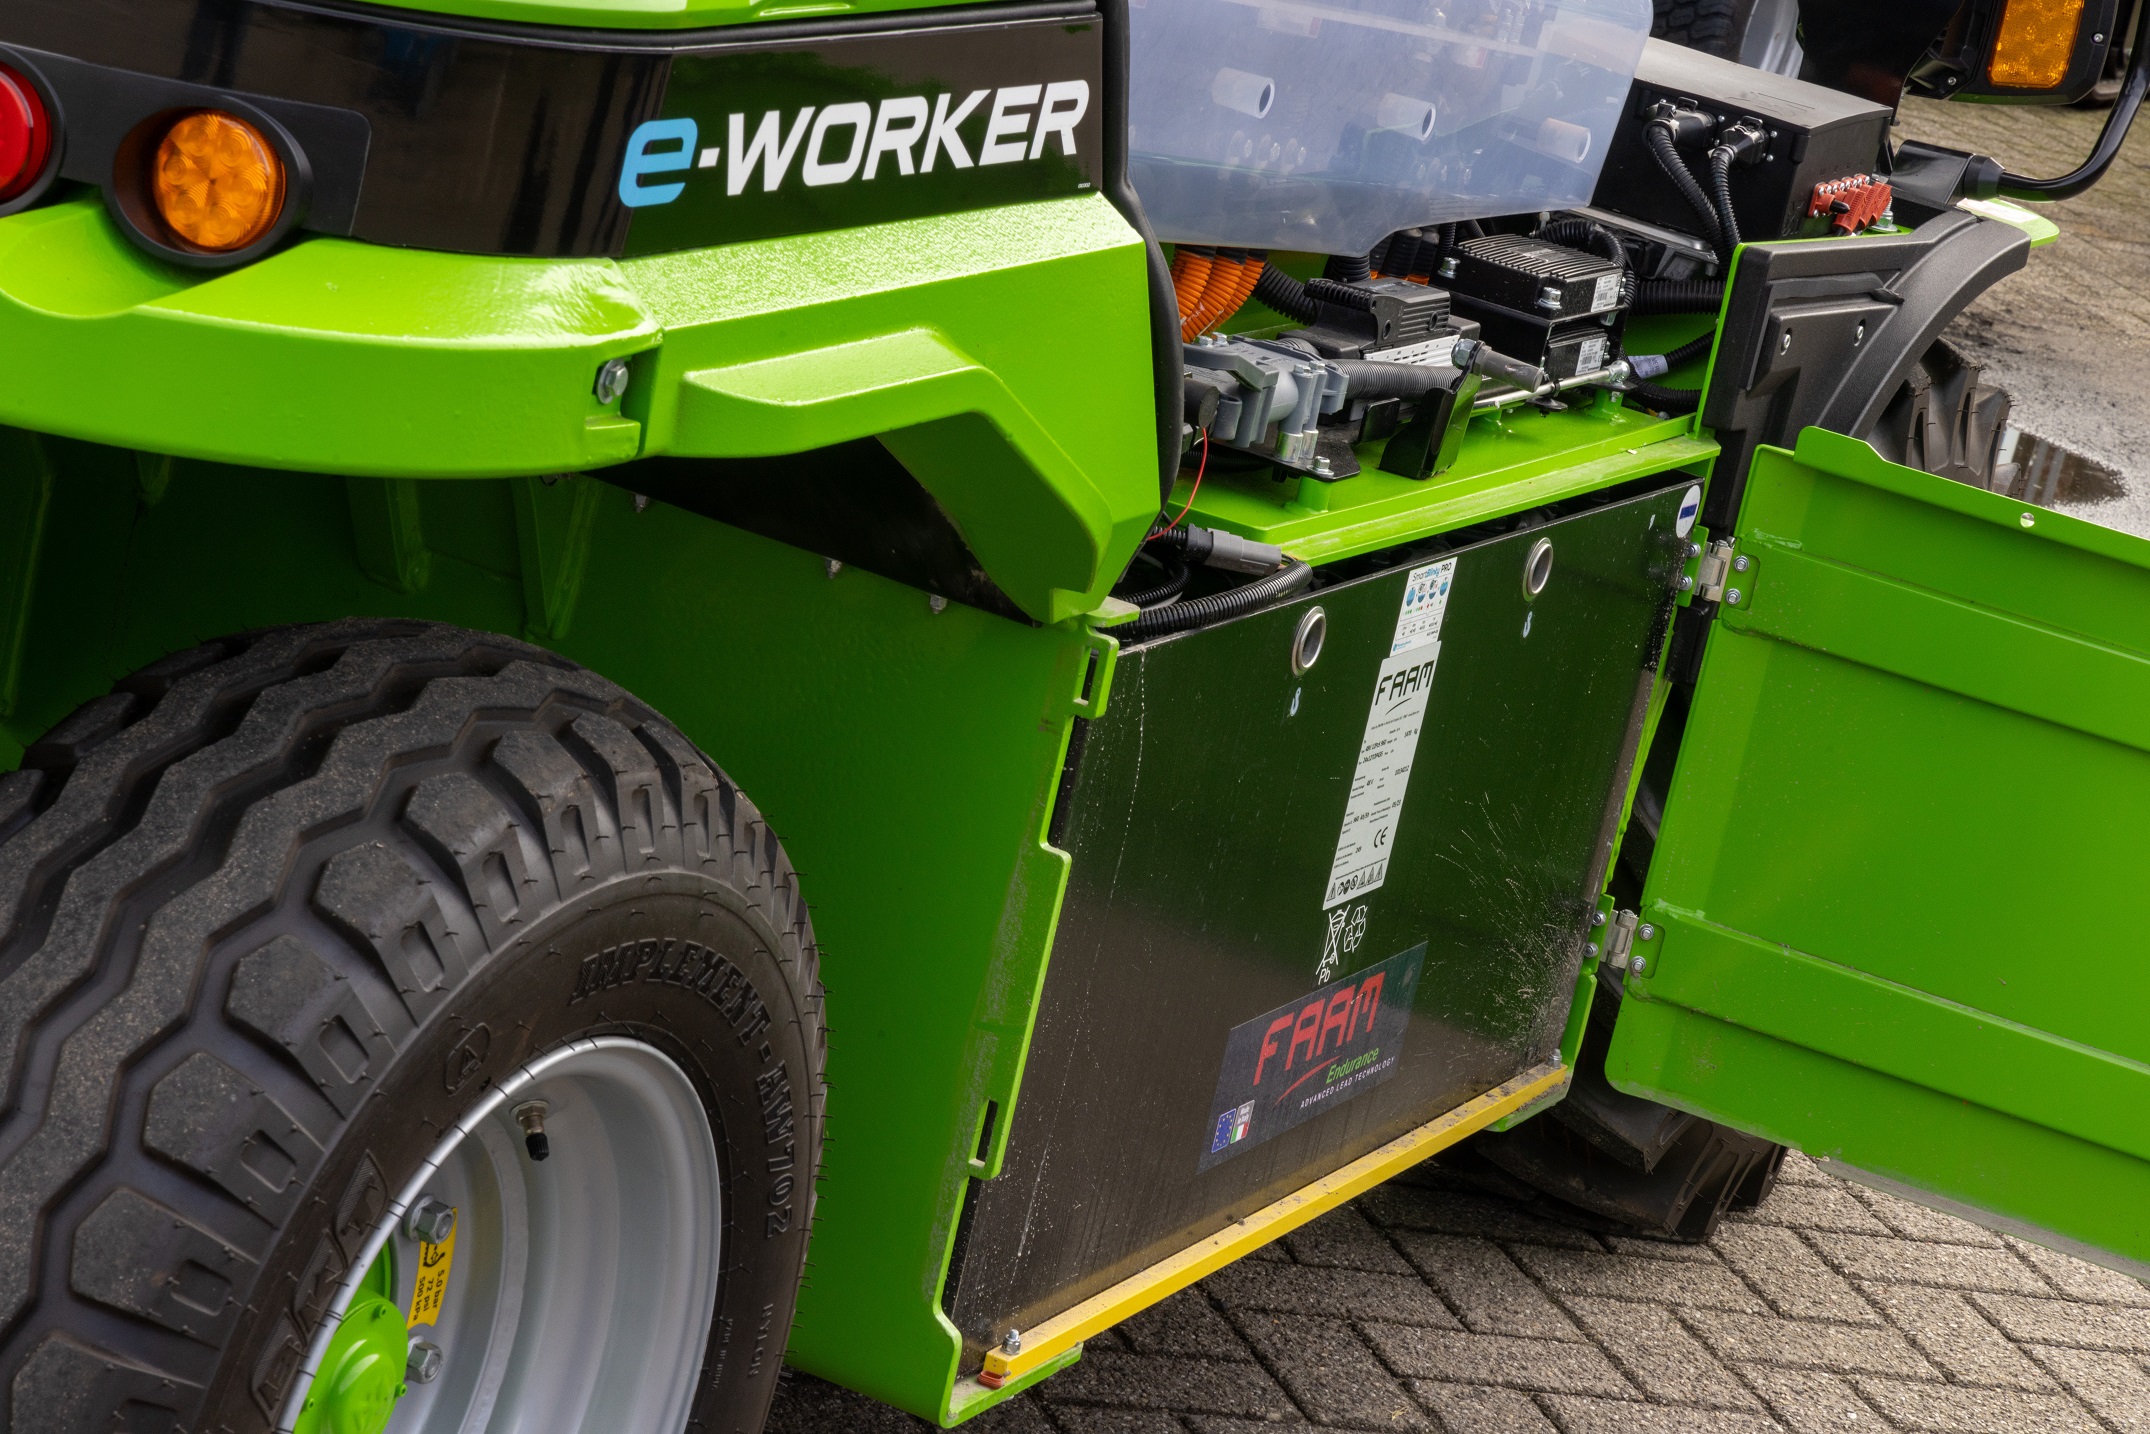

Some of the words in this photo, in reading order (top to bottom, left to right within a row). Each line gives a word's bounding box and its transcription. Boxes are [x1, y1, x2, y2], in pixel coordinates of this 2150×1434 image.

[618, 79, 1090, 208] e-WORKER
[1441, 562, 1452, 574] PRO
[1375, 660, 1434, 706] FAAM
[1317, 966, 1331, 985] Pb
[1253, 971, 1386, 1086] FAAM
[1326, 1047, 1379, 1084] Endurance
[567, 938, 772, 1046] IMPLEMENT
[756, 1060, 795, 1239] AW702
[1300, 1086, 1335, 1109] ADVANCED
[1336, 1077, 1353, 1092] LEAD
[1354, 1056, 1395, 1082] TECHNOLOGY
[417, 1276, 426, 1298] 500
[426, 1277, 434, 1292] 72
[413, 1299, 423, 1321] kPa
[423, 1295, 431, 1312] psi
[432, 1289, 442, 1309] bar
